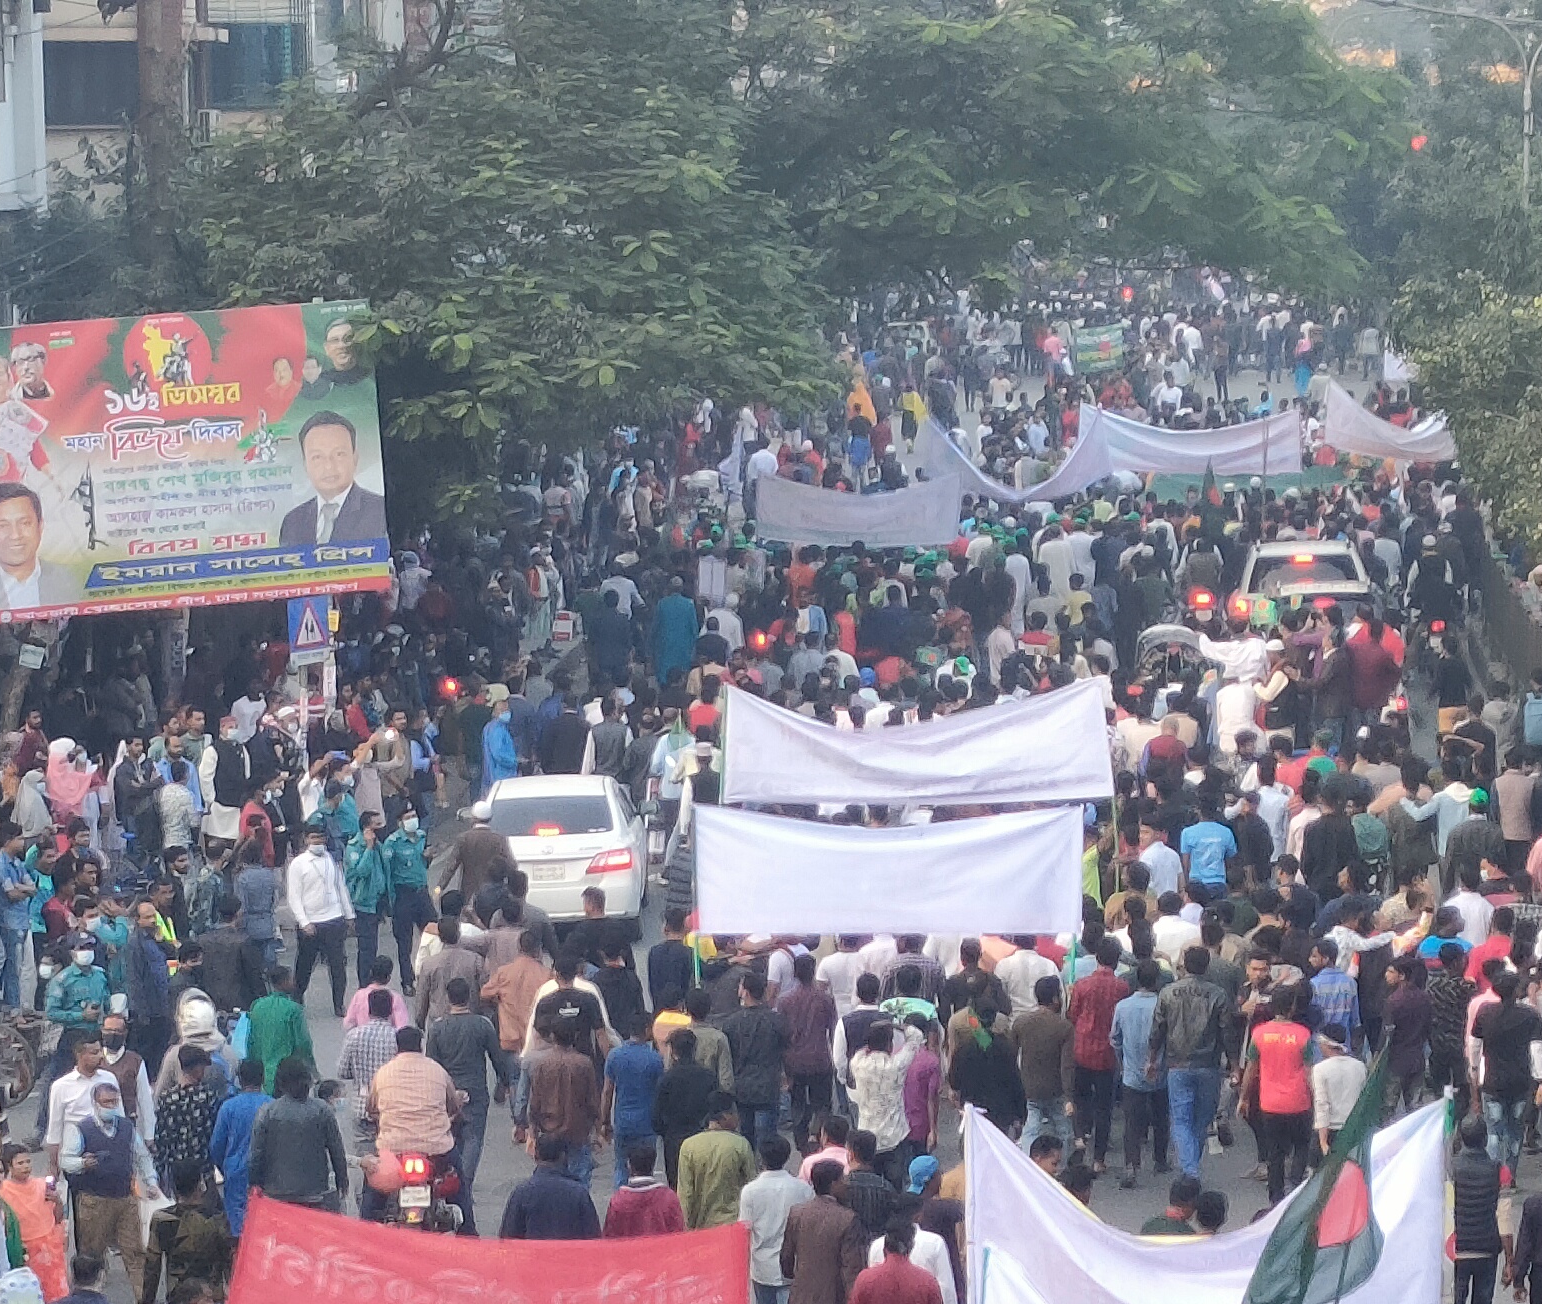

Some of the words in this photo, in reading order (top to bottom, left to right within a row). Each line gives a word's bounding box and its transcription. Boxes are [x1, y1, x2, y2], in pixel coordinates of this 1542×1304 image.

[162, 382, 241, 407] ডিসেম্বর
[61, 432, 107, 453] মহান
[104, 416, 189, 462] বিজয়
[190, 418, 243, 443] দিবস
[157, 475, 186, 488] শেখ
[192, 468, 241, 486] মুজিবুর
[248, 466, 292, 480] রহমান
[201, 502, 232, 515] হাসান
[128, 537, 199, 556] বিনম্র
[212, 531, 267, 551] শ্রদ্ধা
[98, 559, 198, 580] ইমরান
